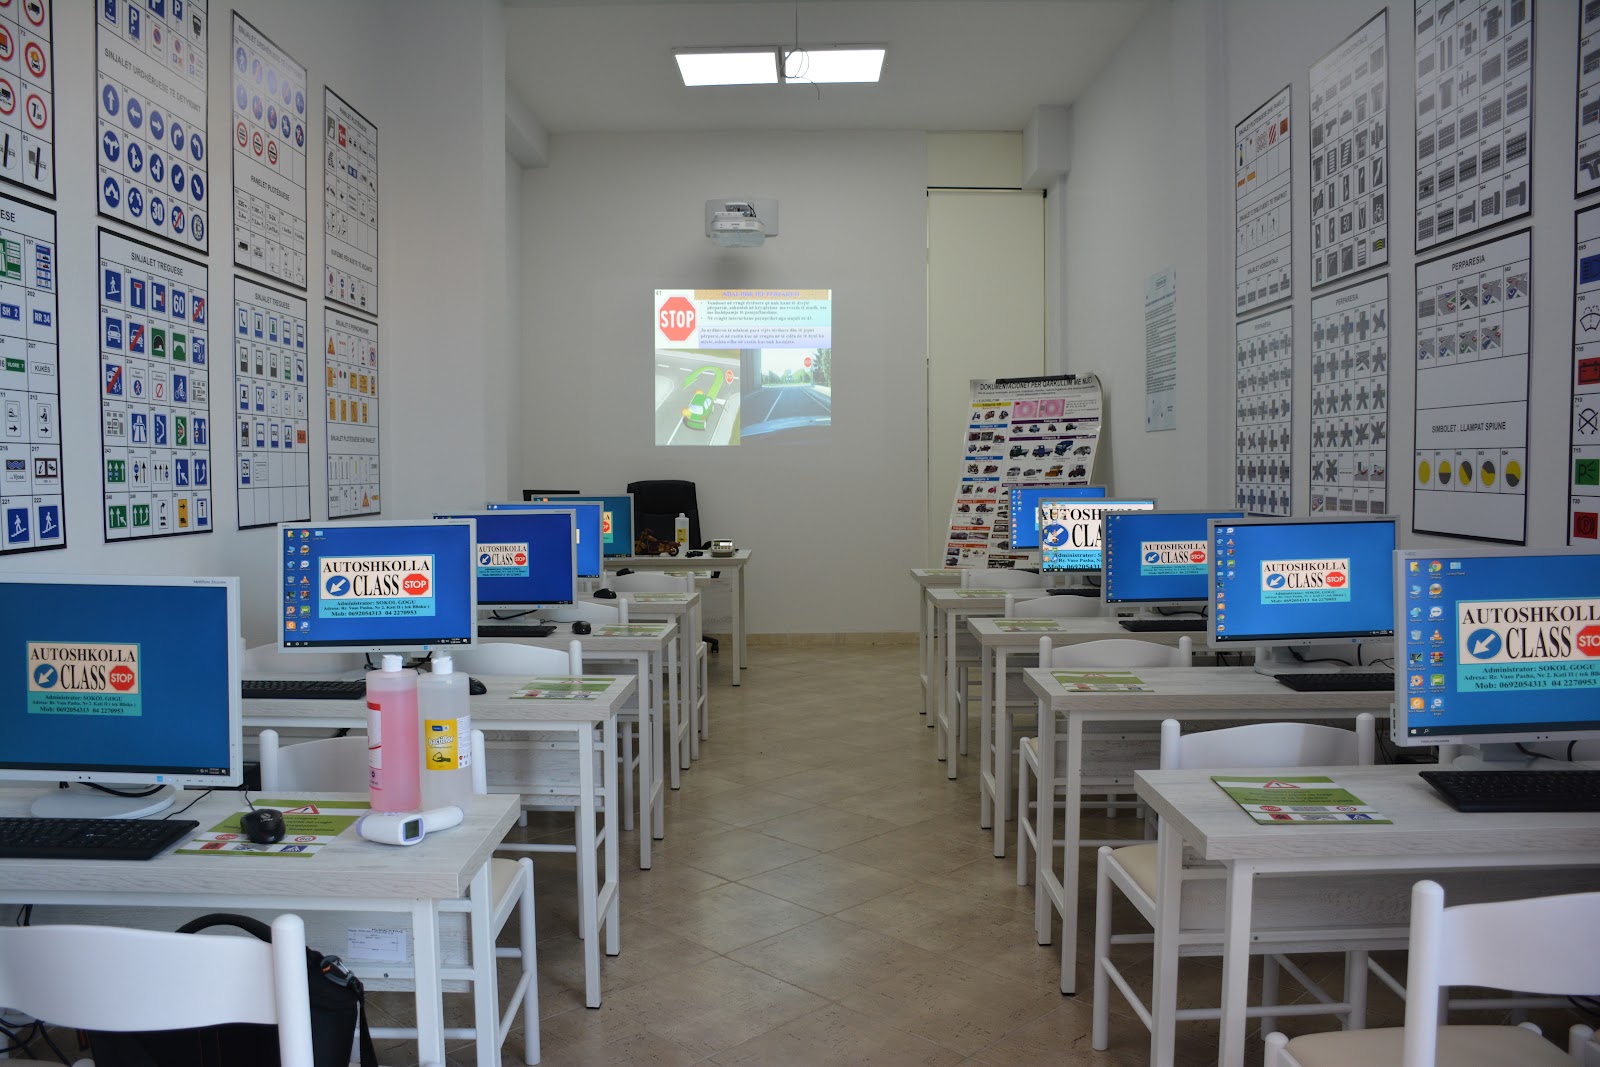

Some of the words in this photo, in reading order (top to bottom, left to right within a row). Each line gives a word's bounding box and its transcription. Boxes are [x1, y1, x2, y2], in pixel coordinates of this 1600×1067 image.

[105, 48, 132, 71] SINJALET
[251, 175, 267, 189] PANELET
[0, 209, 15, 222] ESE
[152, 202, 163, 221] 30
[131, 252, 156, 267] SINJALET
[158, 261, 183, 276] TREGUESE
[1452, 255, 1485, 271] PERPARESIA
[174, 295, 184, 314] 60
[255, 293, 271, 304] SINJALET
[272, 298, 290, 309] TREGUESE
[2, 306, 10, 316] SH
[15, 309, 18, 317] 2
[35, 313, 42, 322] RR
[42, 314, 50, 323] 34
[661, 310, 694, 328] STOP
[980, 382, 1030, 391] DOKUMENTACIONET
[1432, 424, 1456, 433] SIMBOLET
[1460, 422, 1484, 432] LLAMPAT
[1485, 422, 1506, 430] SPIUNE
[1072, 524, 1101, 547] CLA
[492, 553, 513, 565] CLASS
[1161, 551, 1189, 564] CLASS
[323, 560, 430, 573] AUTOSHKOLLA
[1264, 562, 1346, 572] AUTOSHKOLLA
[353, 574, 399, 597] CLASS
[404, 580, 426, 589] STOP
[1287, 572, 1323, 589] CLASS
[1462, 606, 1600, 624] AUTOSHKOLL
[1506, 626, 1571, 659] CLASS
[1578, 635, 1600, 647] STO
[30, 648, 136, 662] AUTOSHKOLLA
[60, 664, 106, 690] CLASS
[111, 674, 133, 683] STOP
